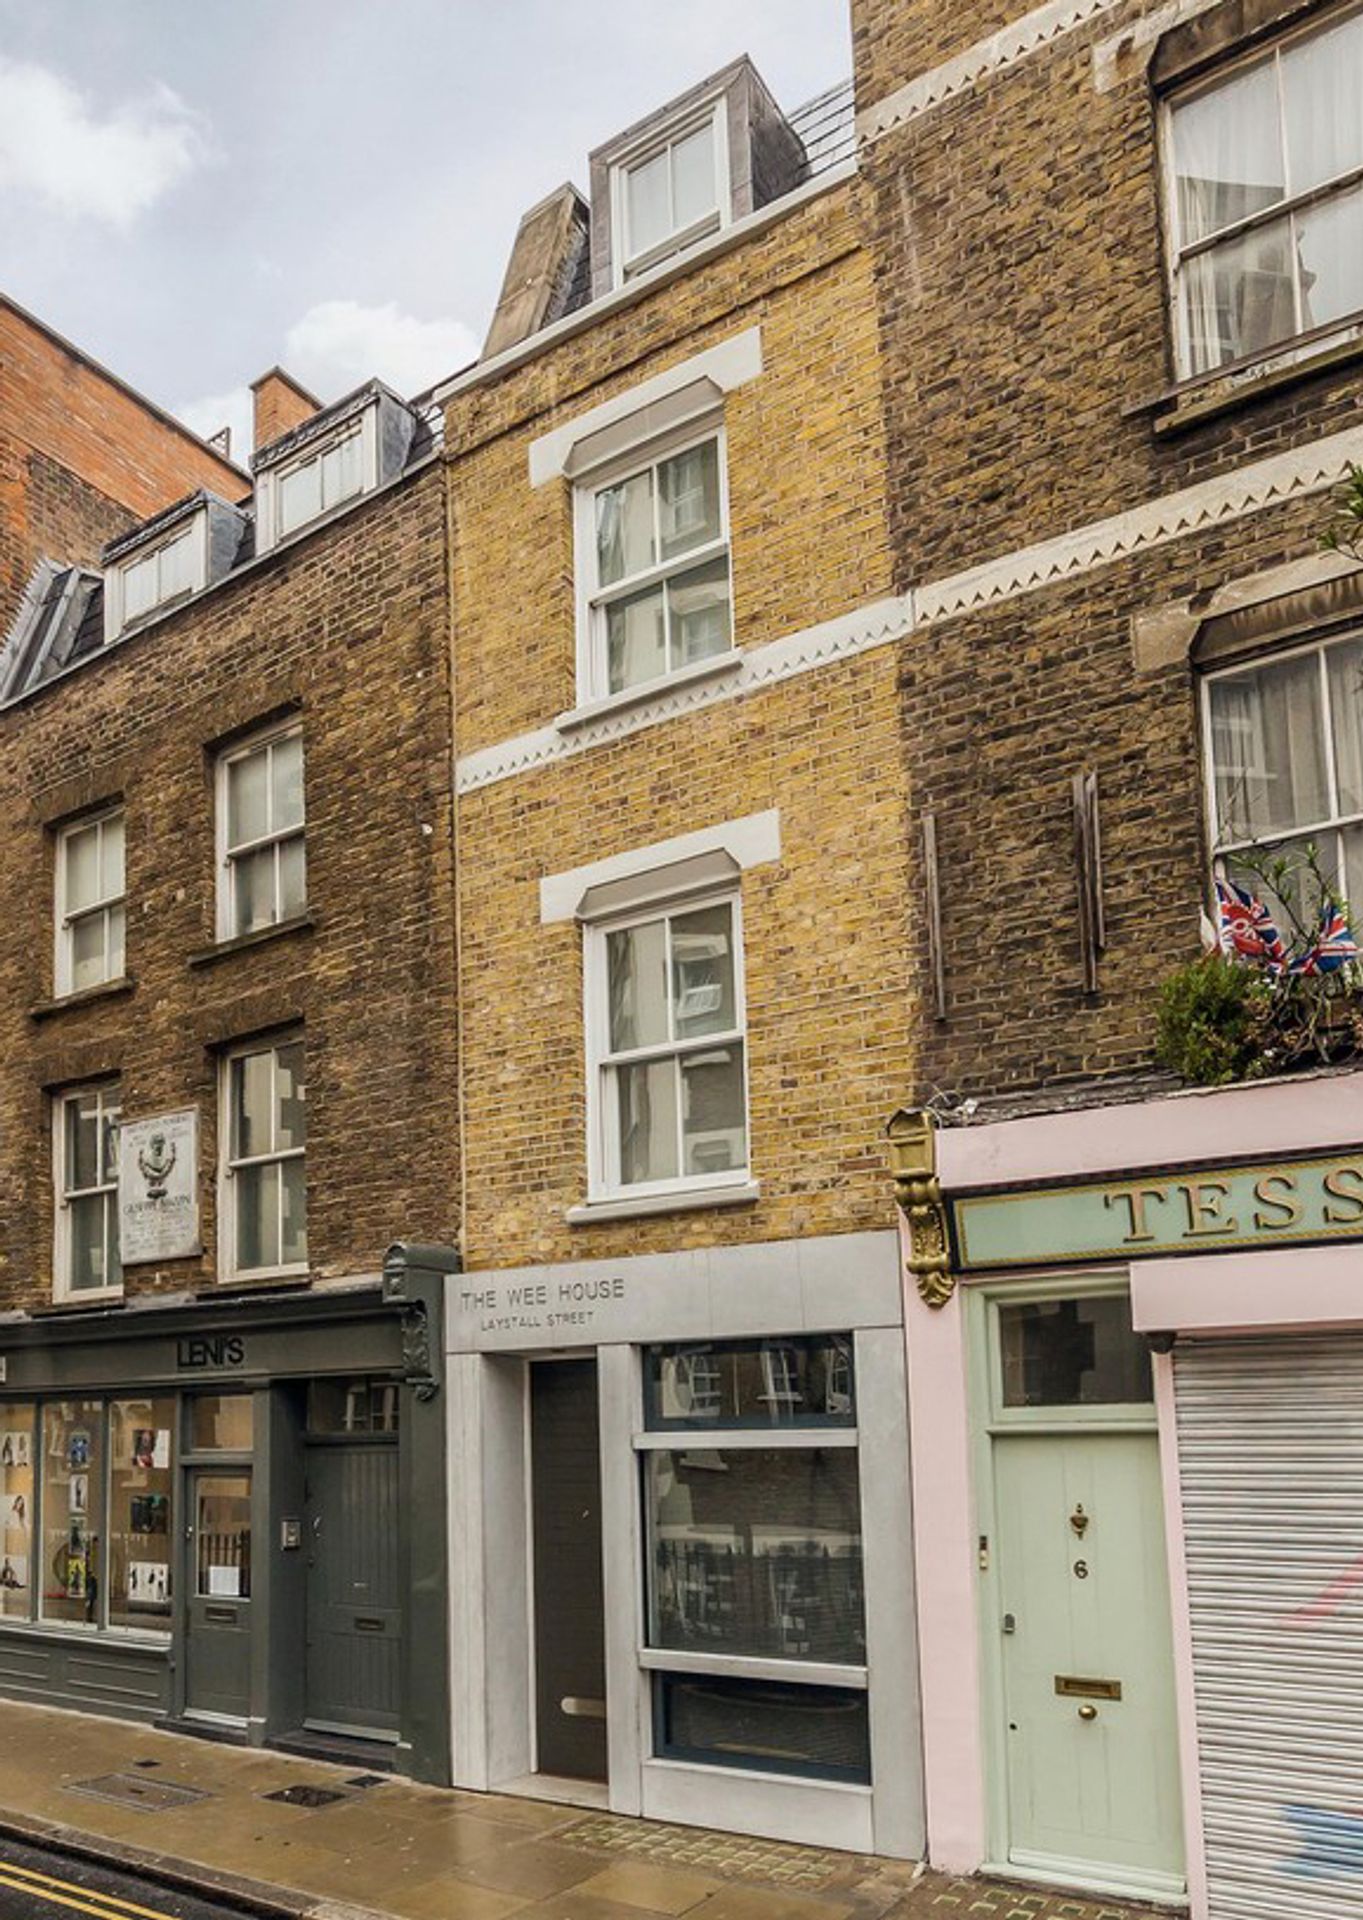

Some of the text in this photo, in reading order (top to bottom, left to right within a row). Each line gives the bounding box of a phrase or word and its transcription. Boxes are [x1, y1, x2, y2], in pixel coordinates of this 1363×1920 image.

[461, 1278, 625, 1310] THE WEE HOUSE
[481, 1311, 593, 1331] LAYSTALL STREET
[1073, 1559, 1089, 1579] 6
